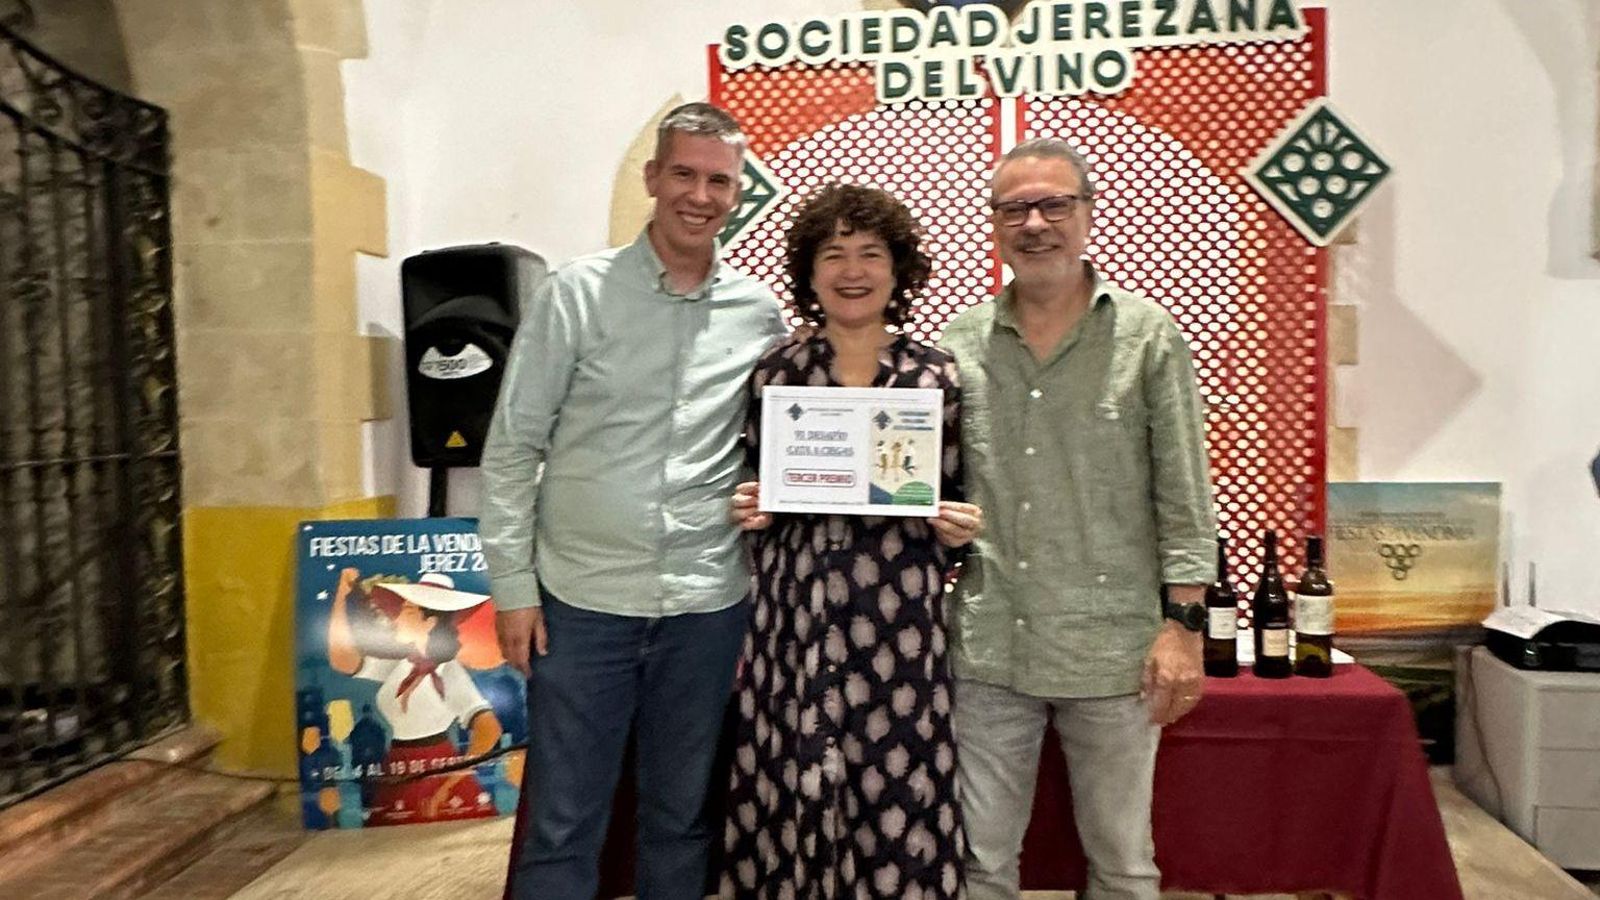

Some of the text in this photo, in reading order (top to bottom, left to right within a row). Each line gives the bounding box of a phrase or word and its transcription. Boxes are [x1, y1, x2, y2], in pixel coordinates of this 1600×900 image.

[725, 0, 1299, 60] SOCIEDAD JEREZANA
[883, 50, 1126, 98] DEL VINO
[786, 472, 854, 484] TERCER PREMIO
[309, 535, 380, 558] FIESTAS
[381, 534, 405, 556] DE
[407, 533, 431, 554] LA
[417, 552, 469, 574] JEREZ
[366, 763, 385, 777] AL
[389, 760, 406, 775] 19
